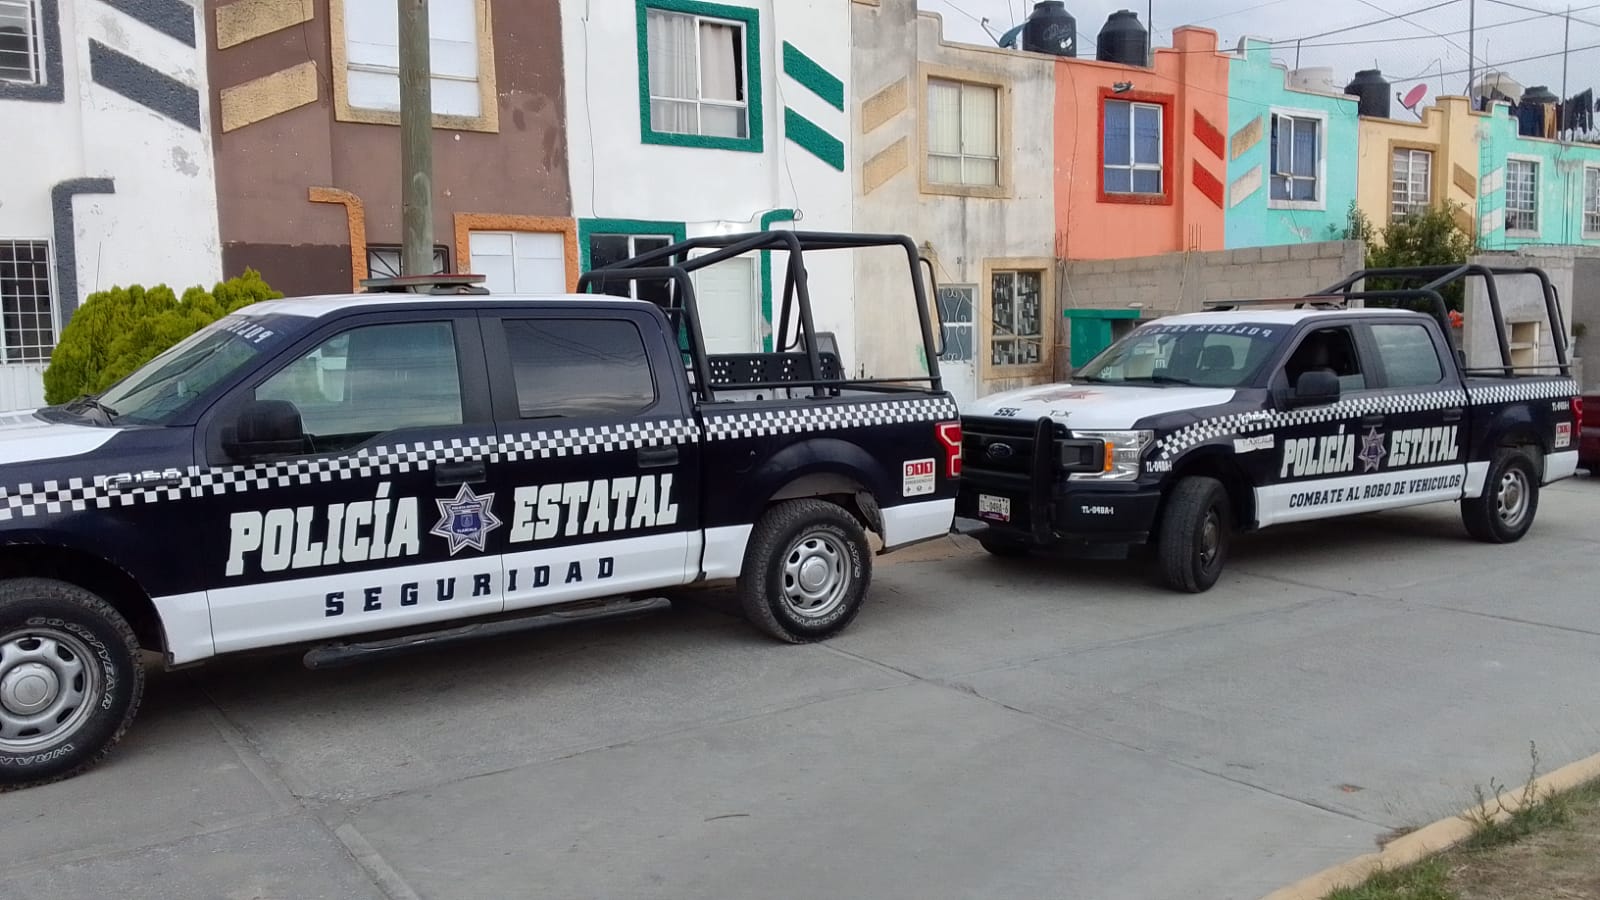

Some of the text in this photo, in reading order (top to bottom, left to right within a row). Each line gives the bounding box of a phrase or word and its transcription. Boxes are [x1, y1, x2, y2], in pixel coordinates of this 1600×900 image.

[994, 407, 1022, 417] SSC
[907, 462, 932, 476] 911
[1280, 424, 1458, 478] POLICÍA ESTATAL
[1289, 474, 1461, 508] COMBATE AL ROBO DE VEHICULOS
[225, 473, 679, 577] POLICÍA ESTATAL
[325, 556, 614, 617] SEGURIDAD
[26, 616, 116, 710] GOODYEAR
